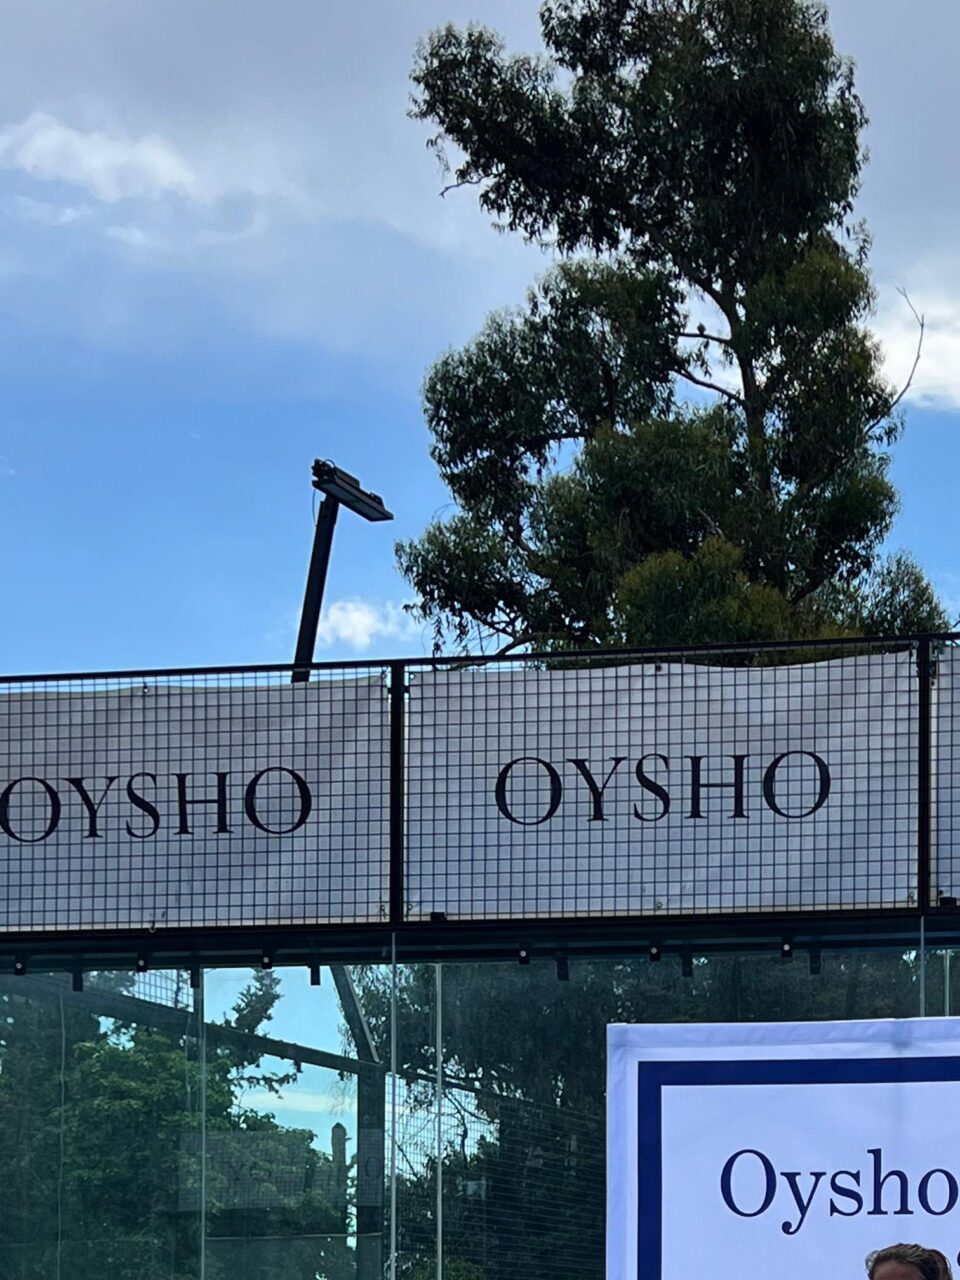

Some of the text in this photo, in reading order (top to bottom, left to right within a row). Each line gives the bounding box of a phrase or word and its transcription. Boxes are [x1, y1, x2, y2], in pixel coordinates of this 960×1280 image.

[0, 766, 313, 843] OYSHO
[494, 749, 832, 826] OYSHO
[720, 1148, 959, 1236] Oysho
